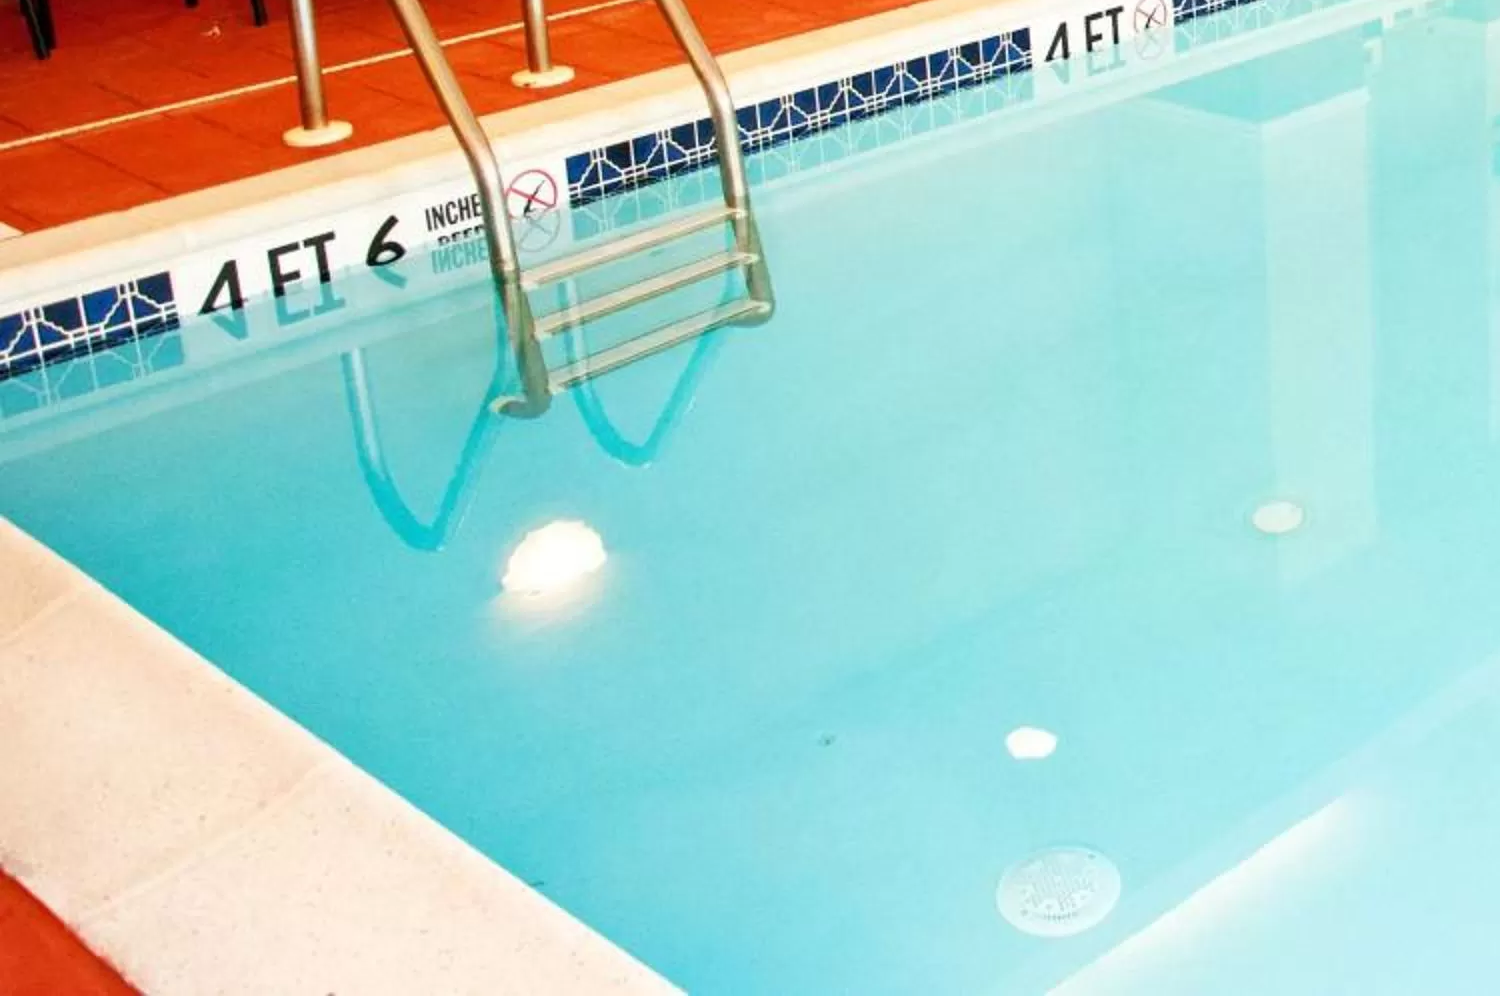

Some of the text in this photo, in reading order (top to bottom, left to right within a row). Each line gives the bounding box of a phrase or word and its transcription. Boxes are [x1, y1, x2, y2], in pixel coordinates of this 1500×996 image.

[1045, 6, 1124, 62] 4 FT
[199, 193, 482, 314] 4 FT 6 INCHE
